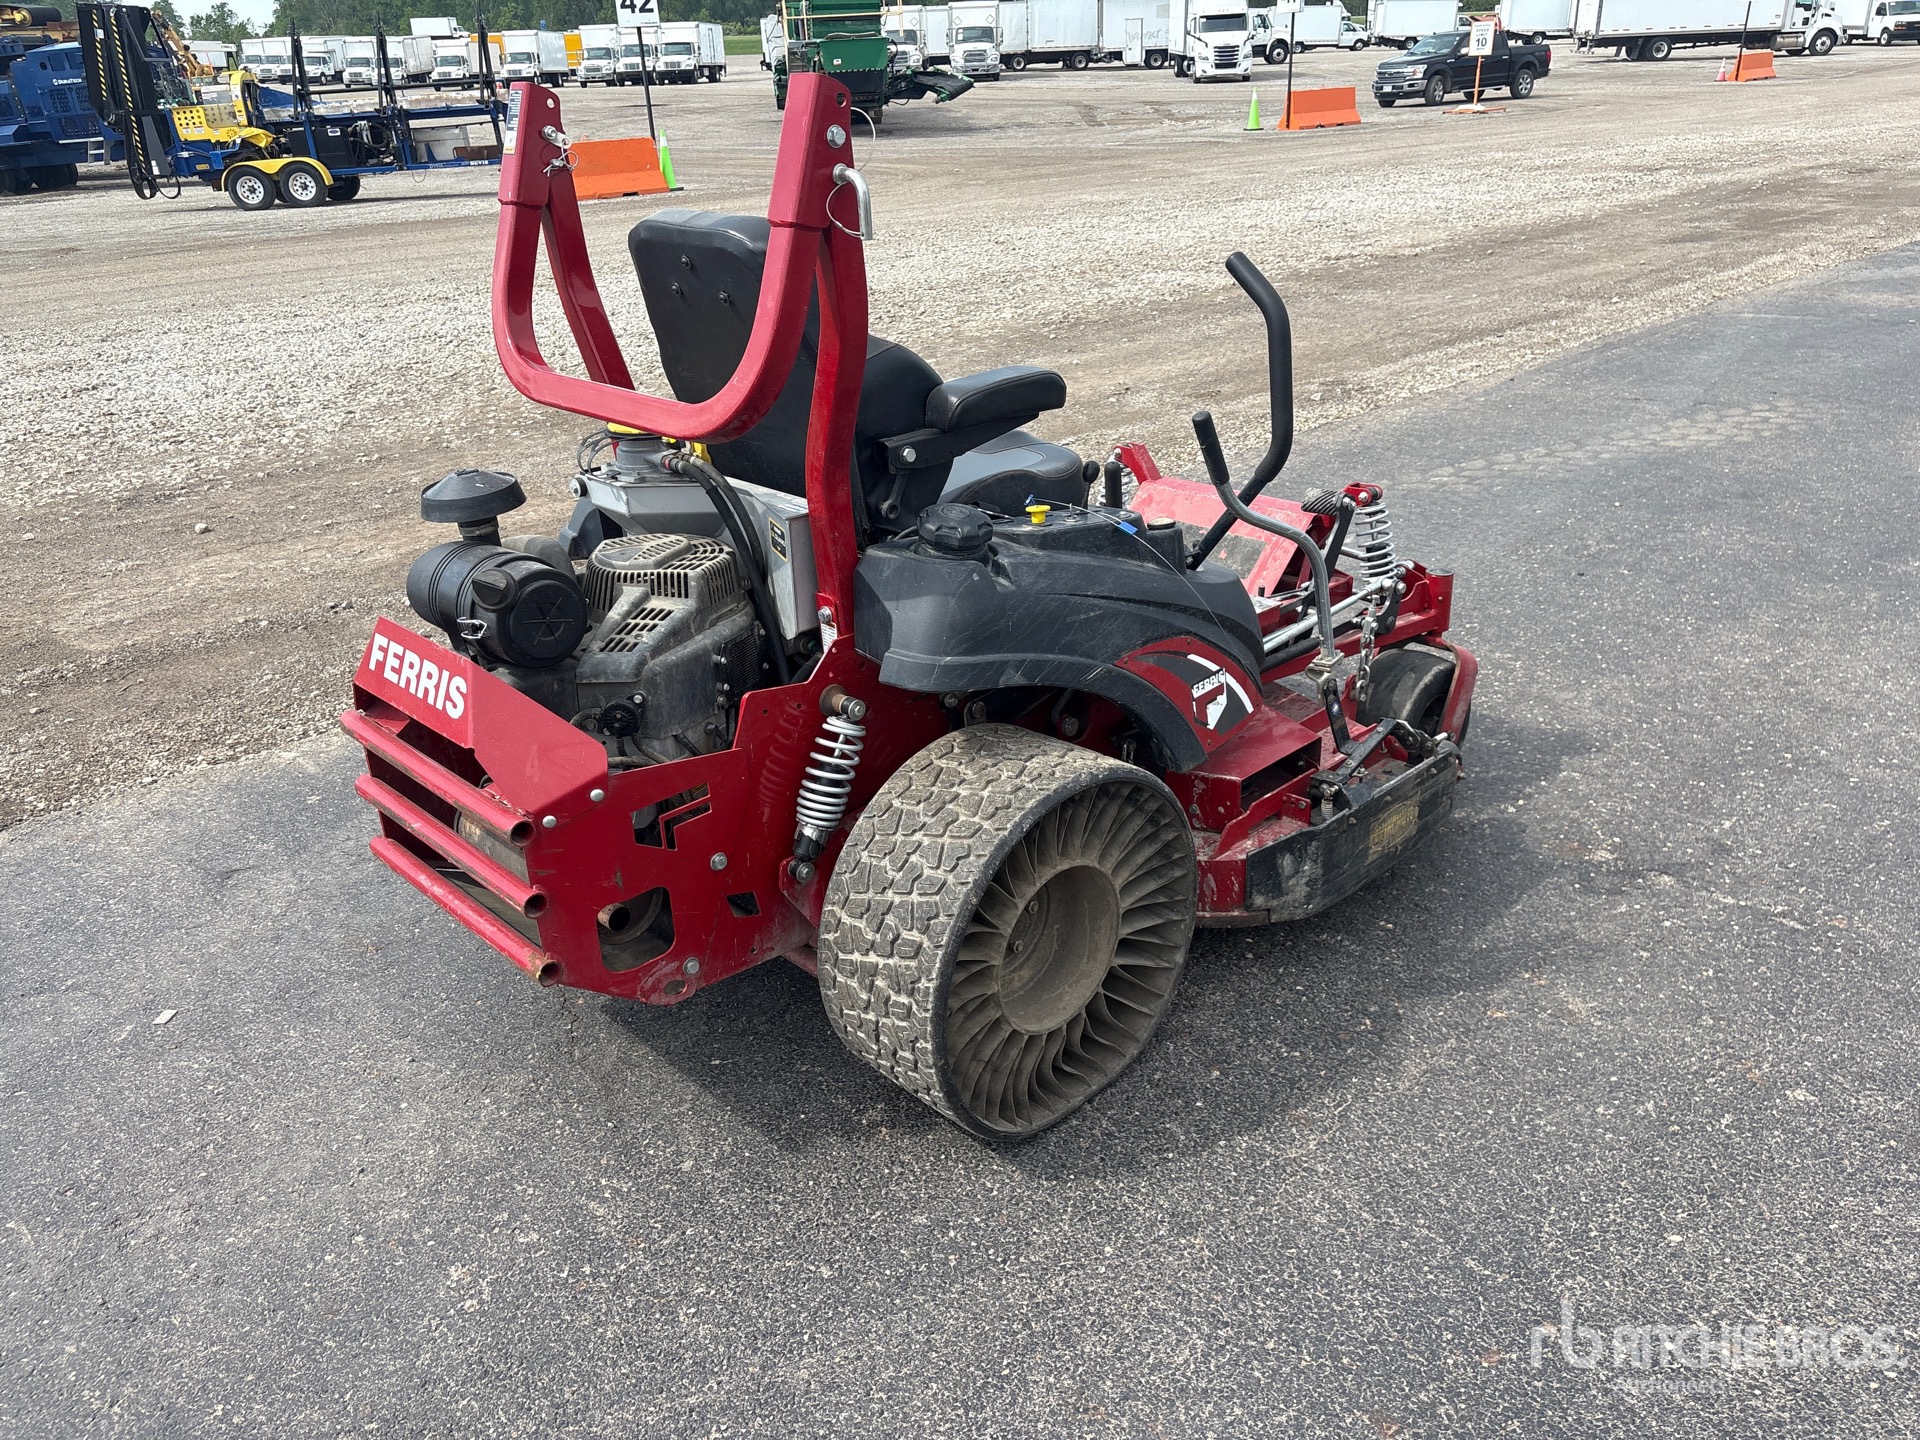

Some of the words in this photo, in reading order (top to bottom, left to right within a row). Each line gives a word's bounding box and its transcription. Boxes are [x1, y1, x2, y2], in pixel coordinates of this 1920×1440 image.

[619, 0, 655, 14] 42
[1475, 37, 1488, 47] 10
[368, 632, 468, 720] FERRIS
